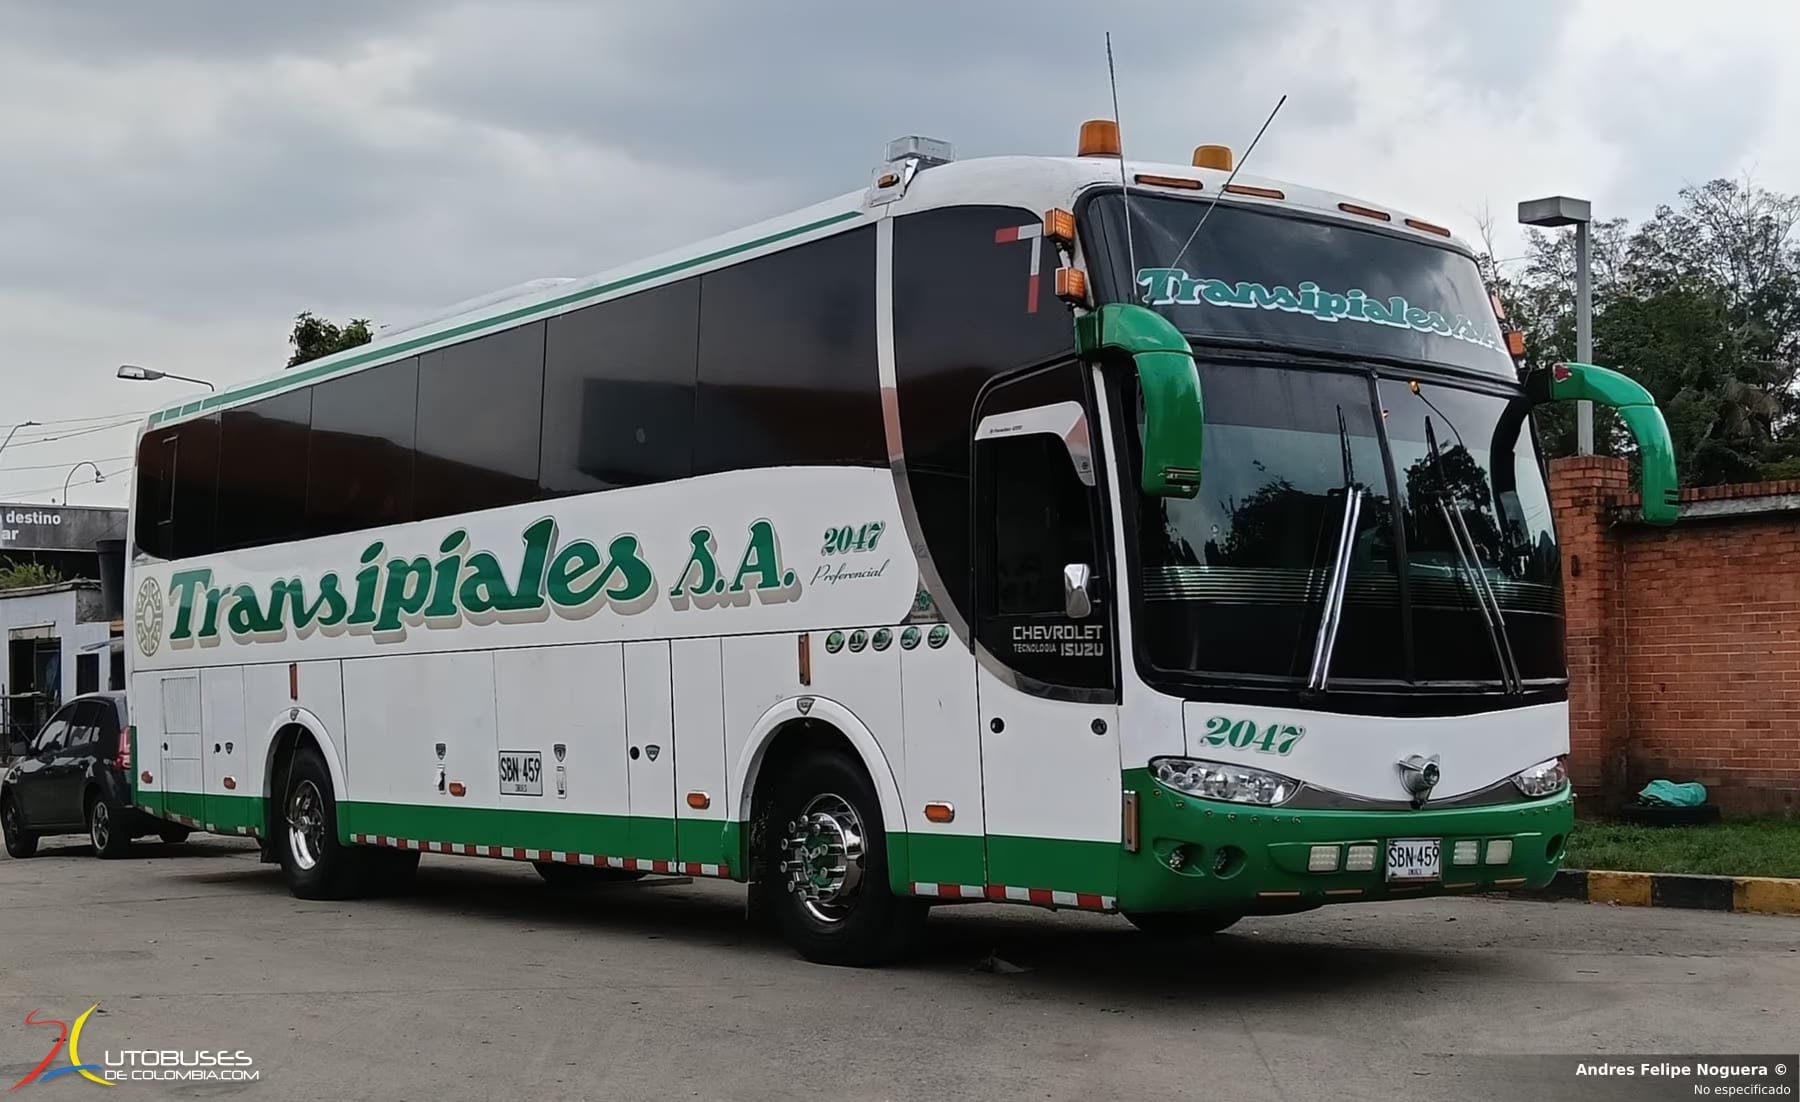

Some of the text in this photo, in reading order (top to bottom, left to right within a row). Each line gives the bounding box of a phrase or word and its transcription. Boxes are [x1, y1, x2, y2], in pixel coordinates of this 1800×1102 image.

[1136, 267, 1453, 337] Transipiales
[5, 510, 61, 525] destino
[820, 521, 886, 556] 2047
[168, 514, 802, 639] Transipiales S.A.
[809, 559, 890, 586] Preferencial
[1012, 624, 1104, 640] CHEVROLET
[1060, 642, 1104, 656] ISUZU
[1199, 716, 1306, 756] 2047
